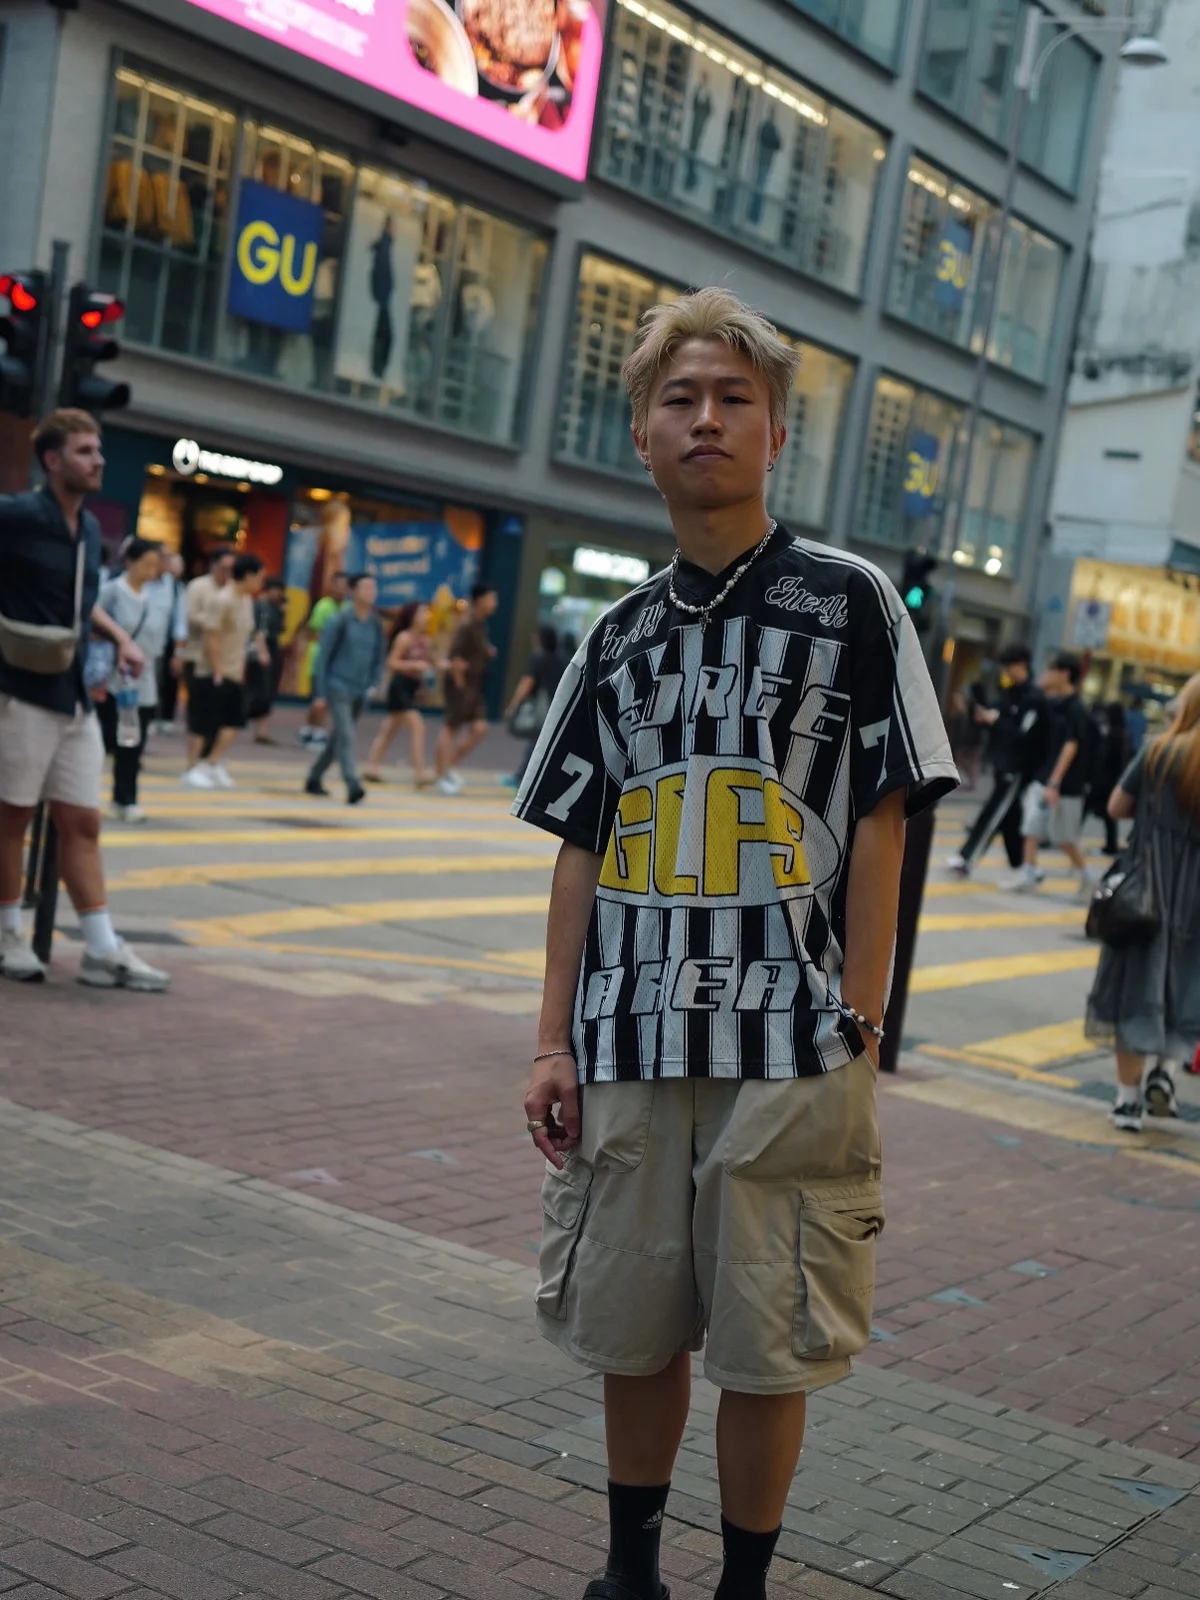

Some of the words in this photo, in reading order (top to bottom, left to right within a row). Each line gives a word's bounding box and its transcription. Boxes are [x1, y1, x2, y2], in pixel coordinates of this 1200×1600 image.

[237, 220, 317, 296] GU
[600, 601, 667, 661] Engy
[765, 576, 849, 628] Energy
[544, 752, 593, 822] 7
[859, 716, 889, 791] 7
